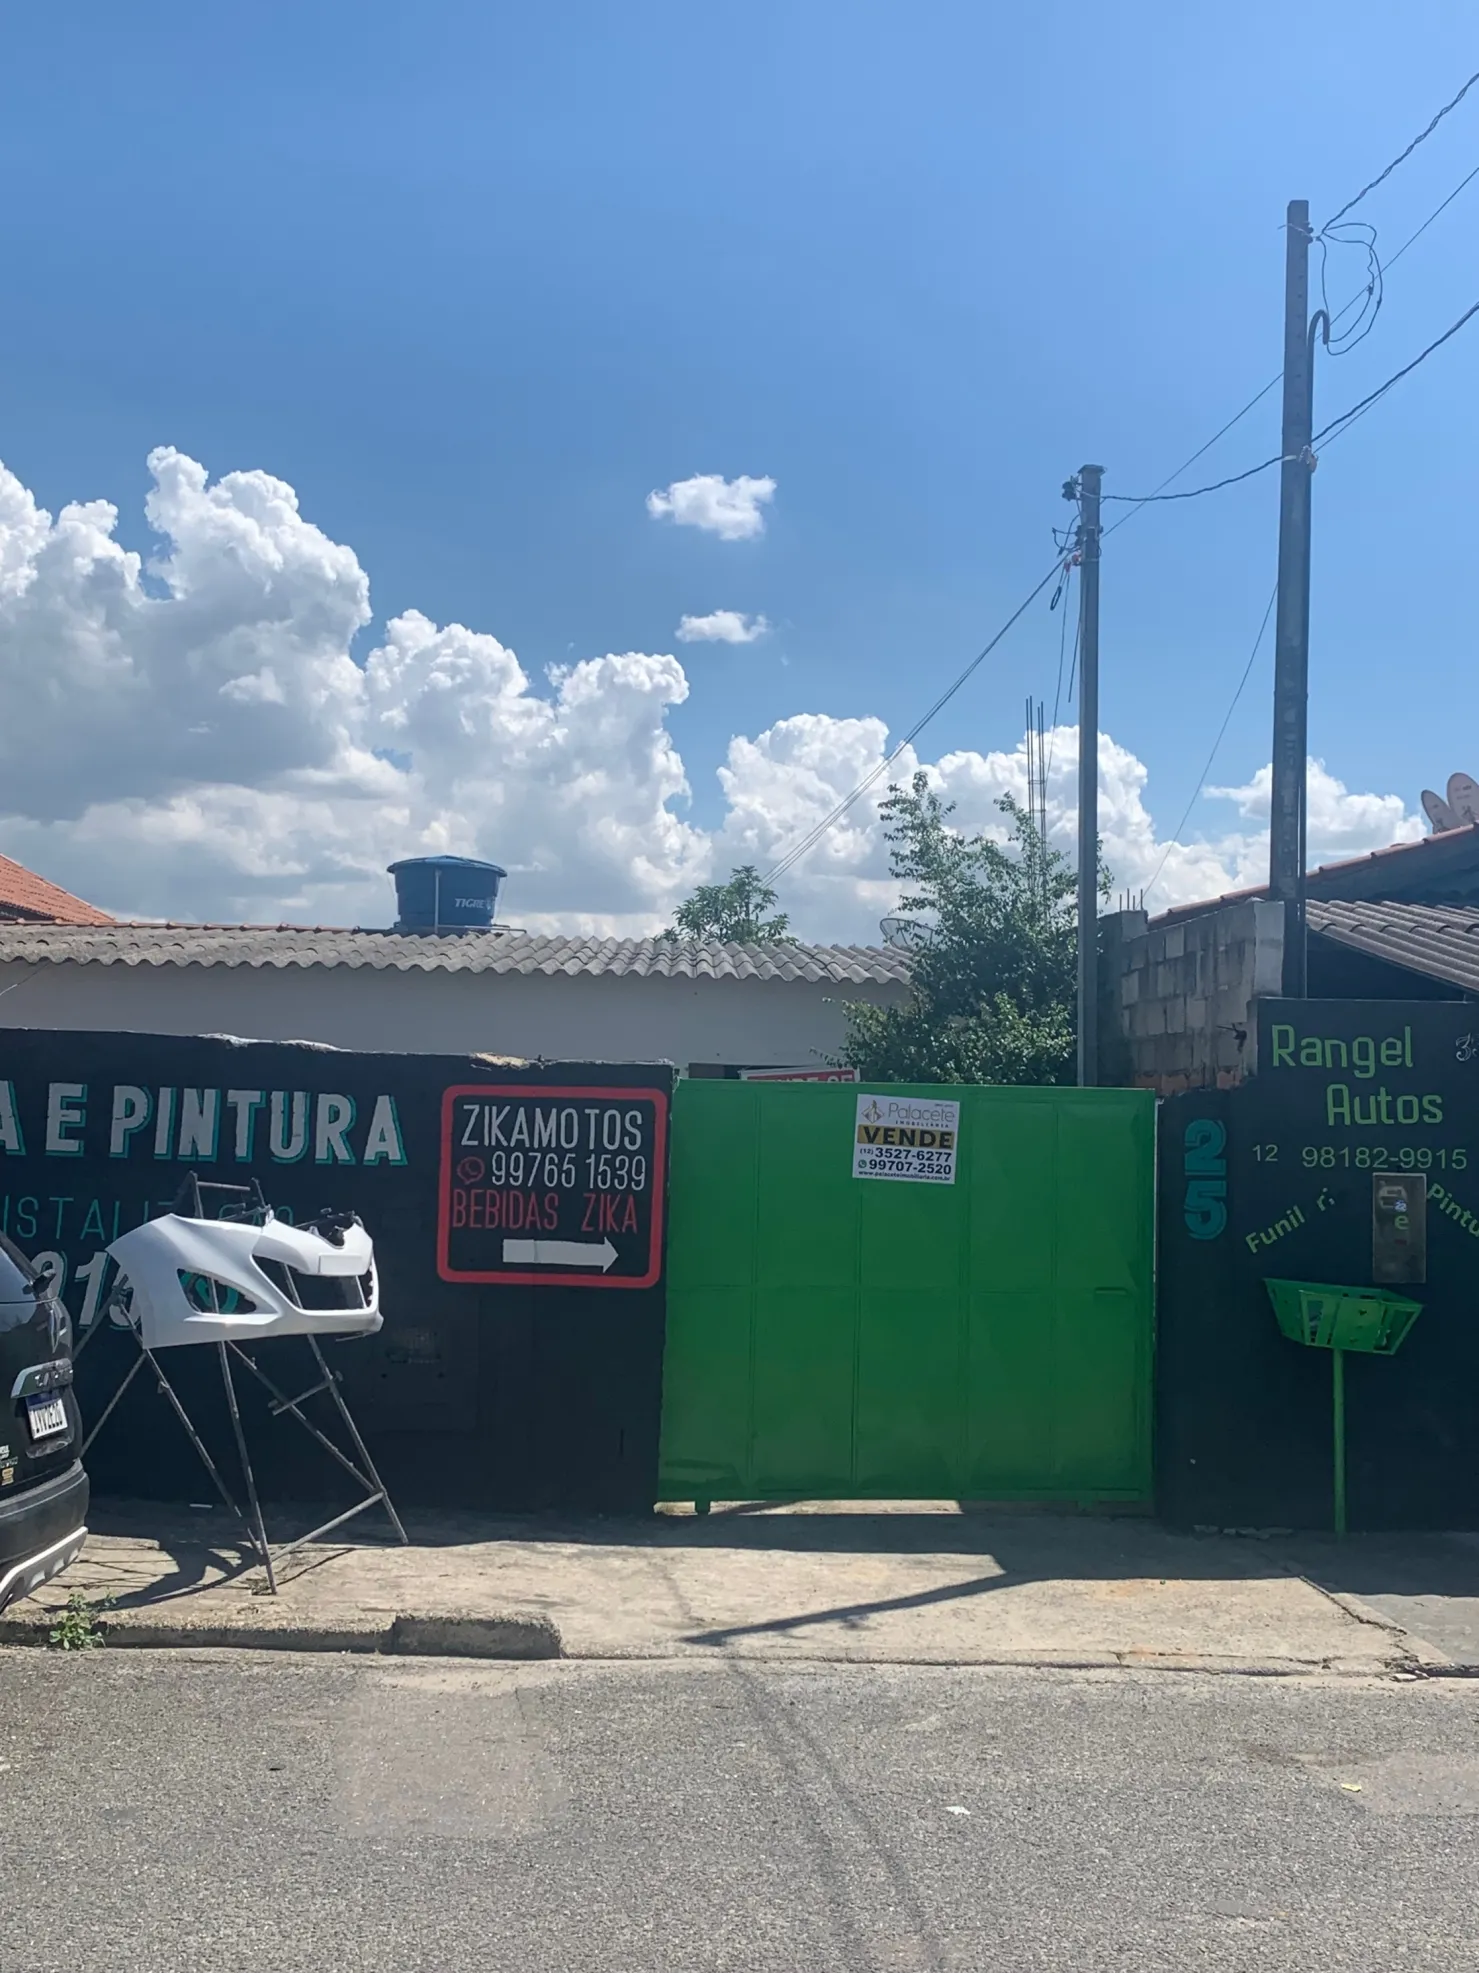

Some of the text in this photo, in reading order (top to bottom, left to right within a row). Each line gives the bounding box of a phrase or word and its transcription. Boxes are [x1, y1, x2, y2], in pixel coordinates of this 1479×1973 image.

[454, 898, 485, 908] TIGRE
[1271, 1024, 1414, 1079] Rangel
[888, 1102, 955, 1123] Palacete
[1325, 1084, 1444, 1126] Autos
[46, 1083, 87, 1157] E
[110, 1085, 407, 1166] PINTURA
[863, 1126, 953, 1148] VENDE
[492, 1151, 646, 1191] 99765 1539
[869, 1159, 952, 1175] 99707-2520
[875, 1147, 952, 1163] 3527-6277
[1252, 1144, 1468, 1170] 12 98182-9915
[1184, 1119, 1227, 1240] 25
[452, 1190, 638, 1233] BEBIDAS ZIKA
